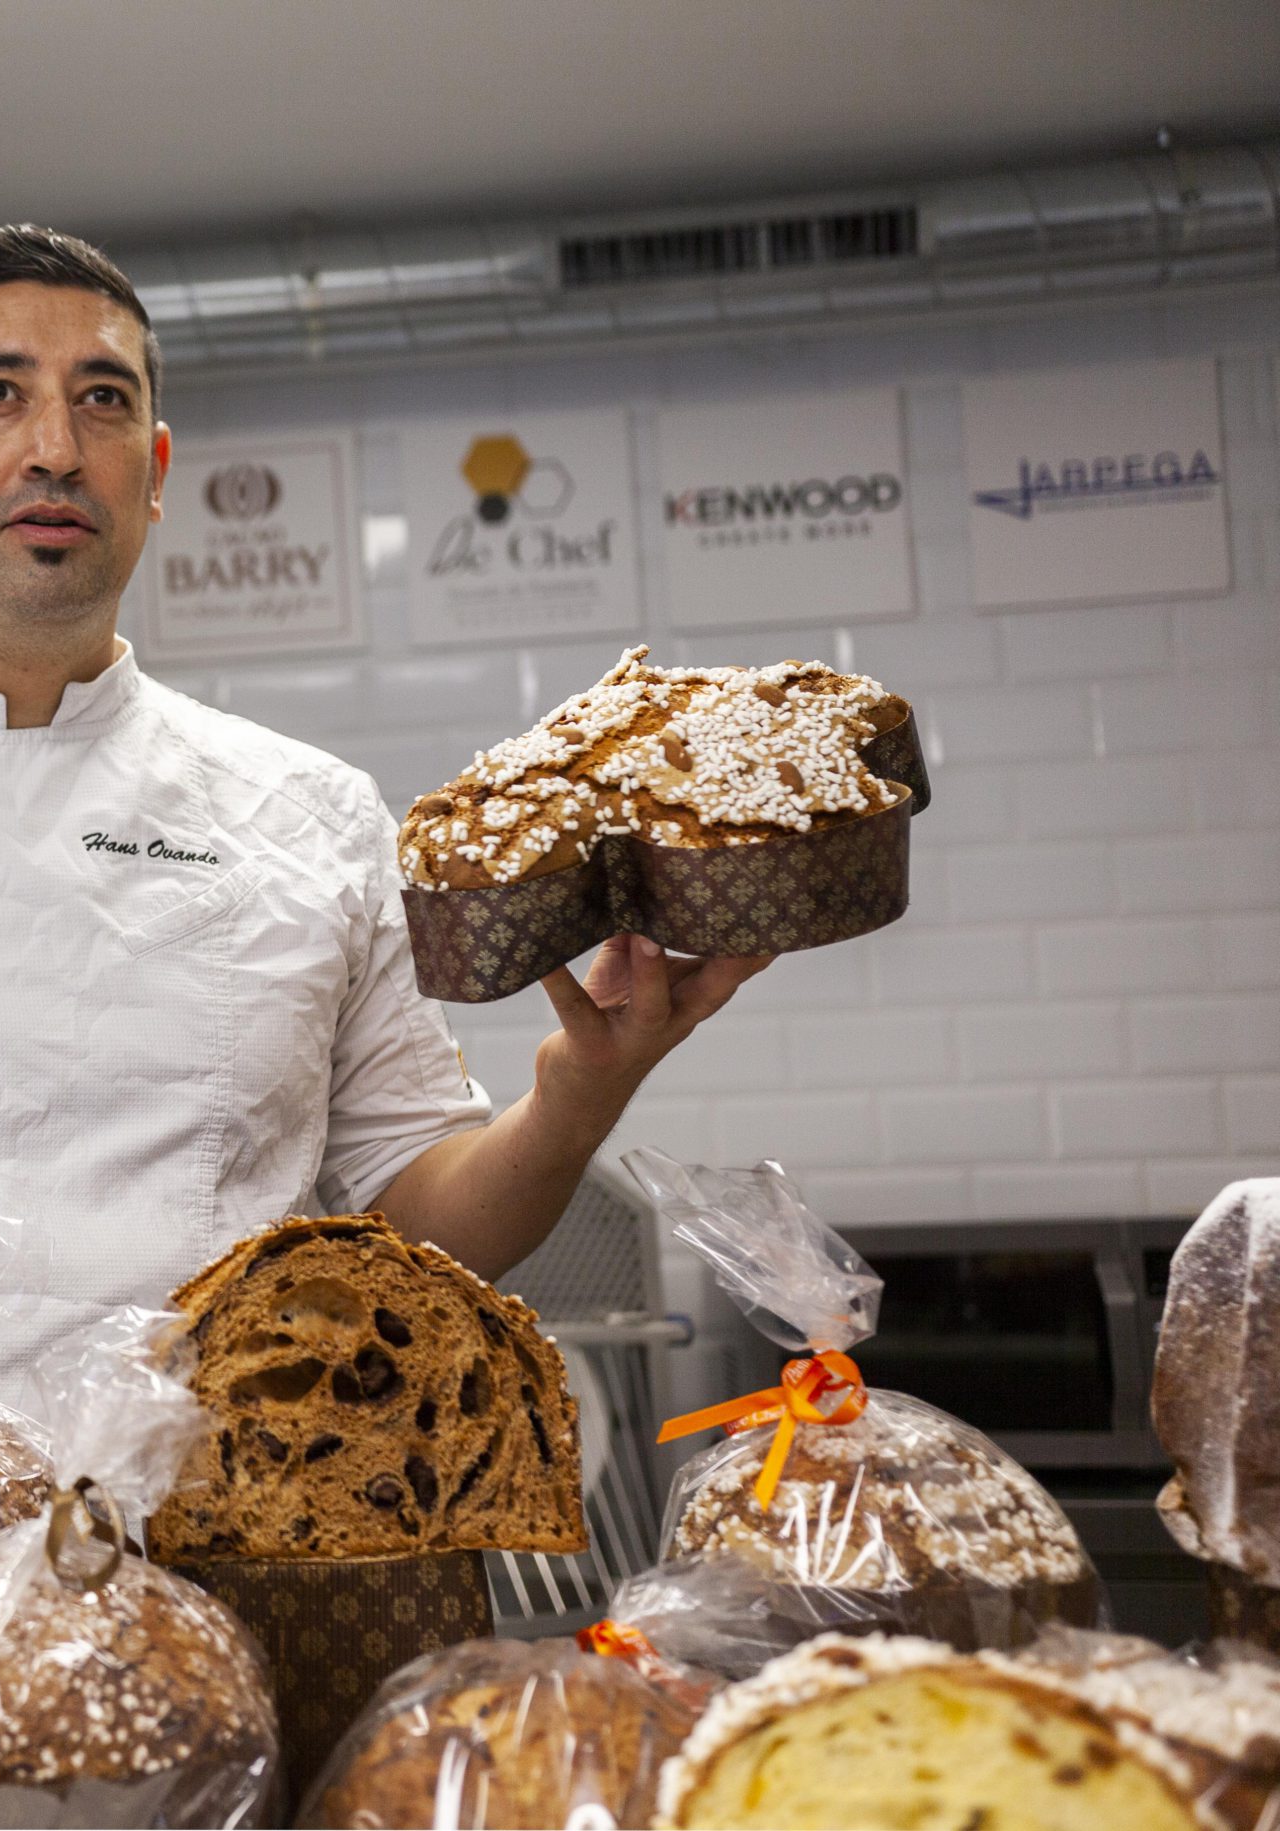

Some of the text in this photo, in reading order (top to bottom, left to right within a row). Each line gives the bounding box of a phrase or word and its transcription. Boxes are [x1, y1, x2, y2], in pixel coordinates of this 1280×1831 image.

[665, 473, 902, 527] KENWOOD
[164, 544, 328, 595] BARRY
[82, 832, 220, 865] Hans Ovando
